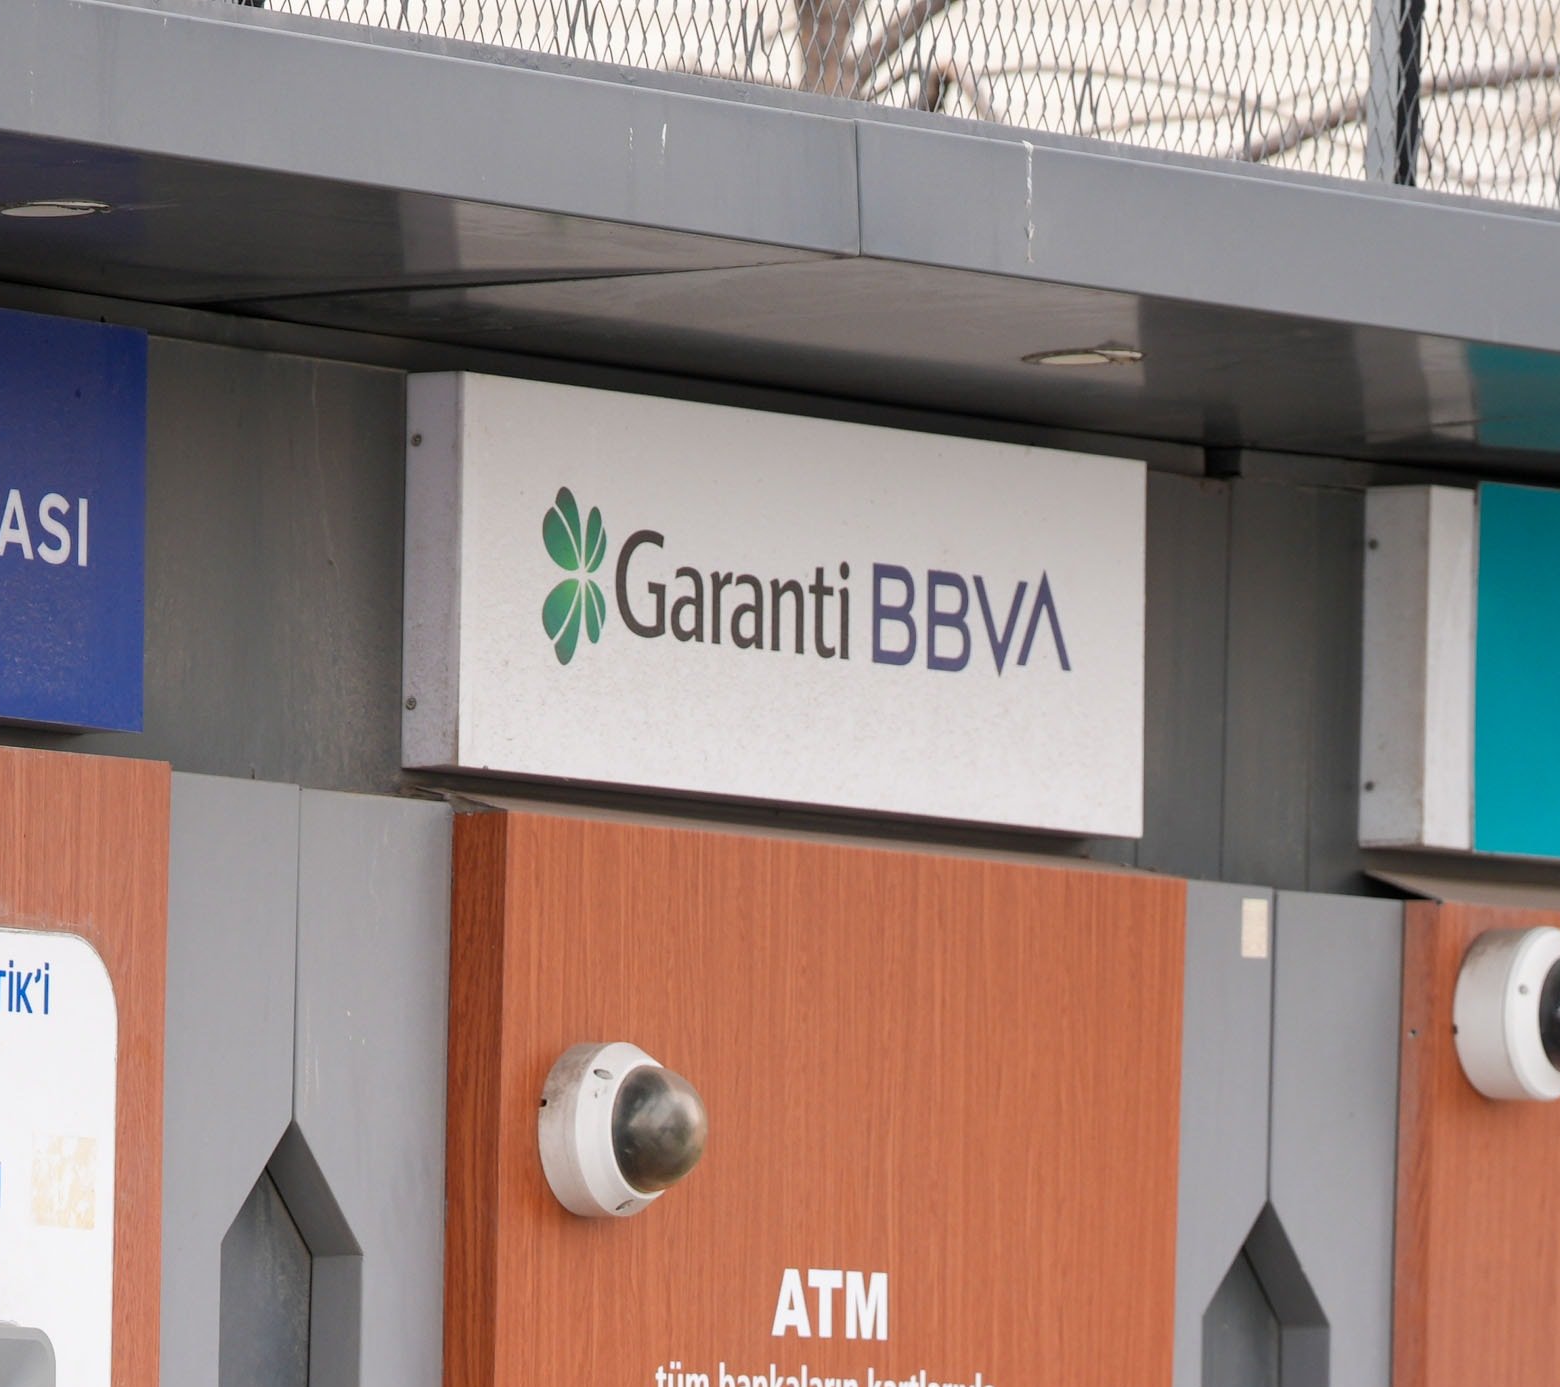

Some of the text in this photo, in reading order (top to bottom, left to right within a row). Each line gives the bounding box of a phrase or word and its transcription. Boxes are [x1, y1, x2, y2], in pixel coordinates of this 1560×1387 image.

[616, 530, 1071, 677] Garanti BBVA
[771, 1268, 889, 1341] ATM
